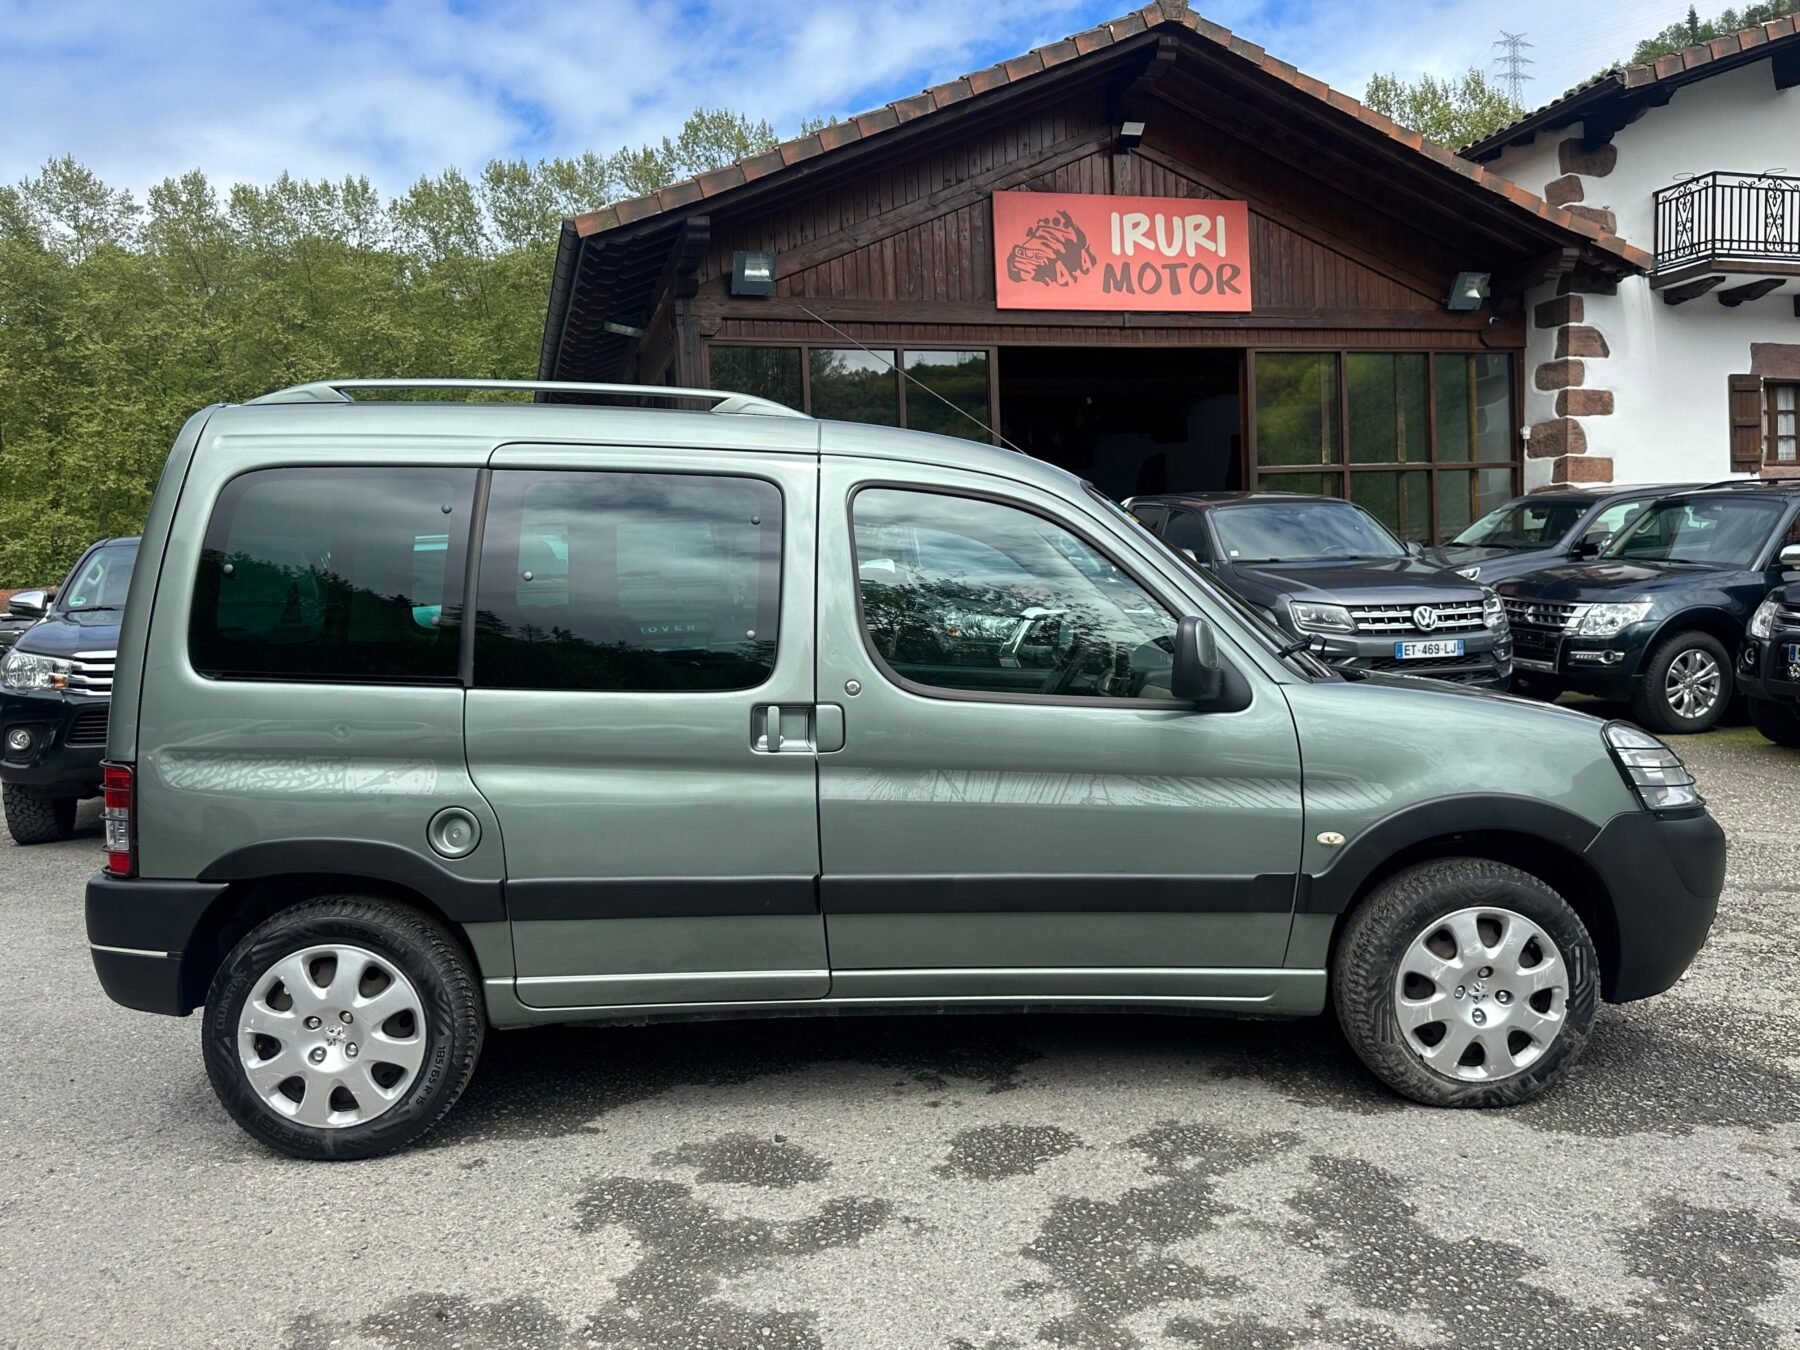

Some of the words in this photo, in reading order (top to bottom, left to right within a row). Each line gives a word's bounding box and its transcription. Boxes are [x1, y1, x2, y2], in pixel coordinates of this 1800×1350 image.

[1111, 211, 1226, 257] IRURI
[1102, 261, 1242, 295] MOTOR
[428, 1045, 446, 1083] 185/65
